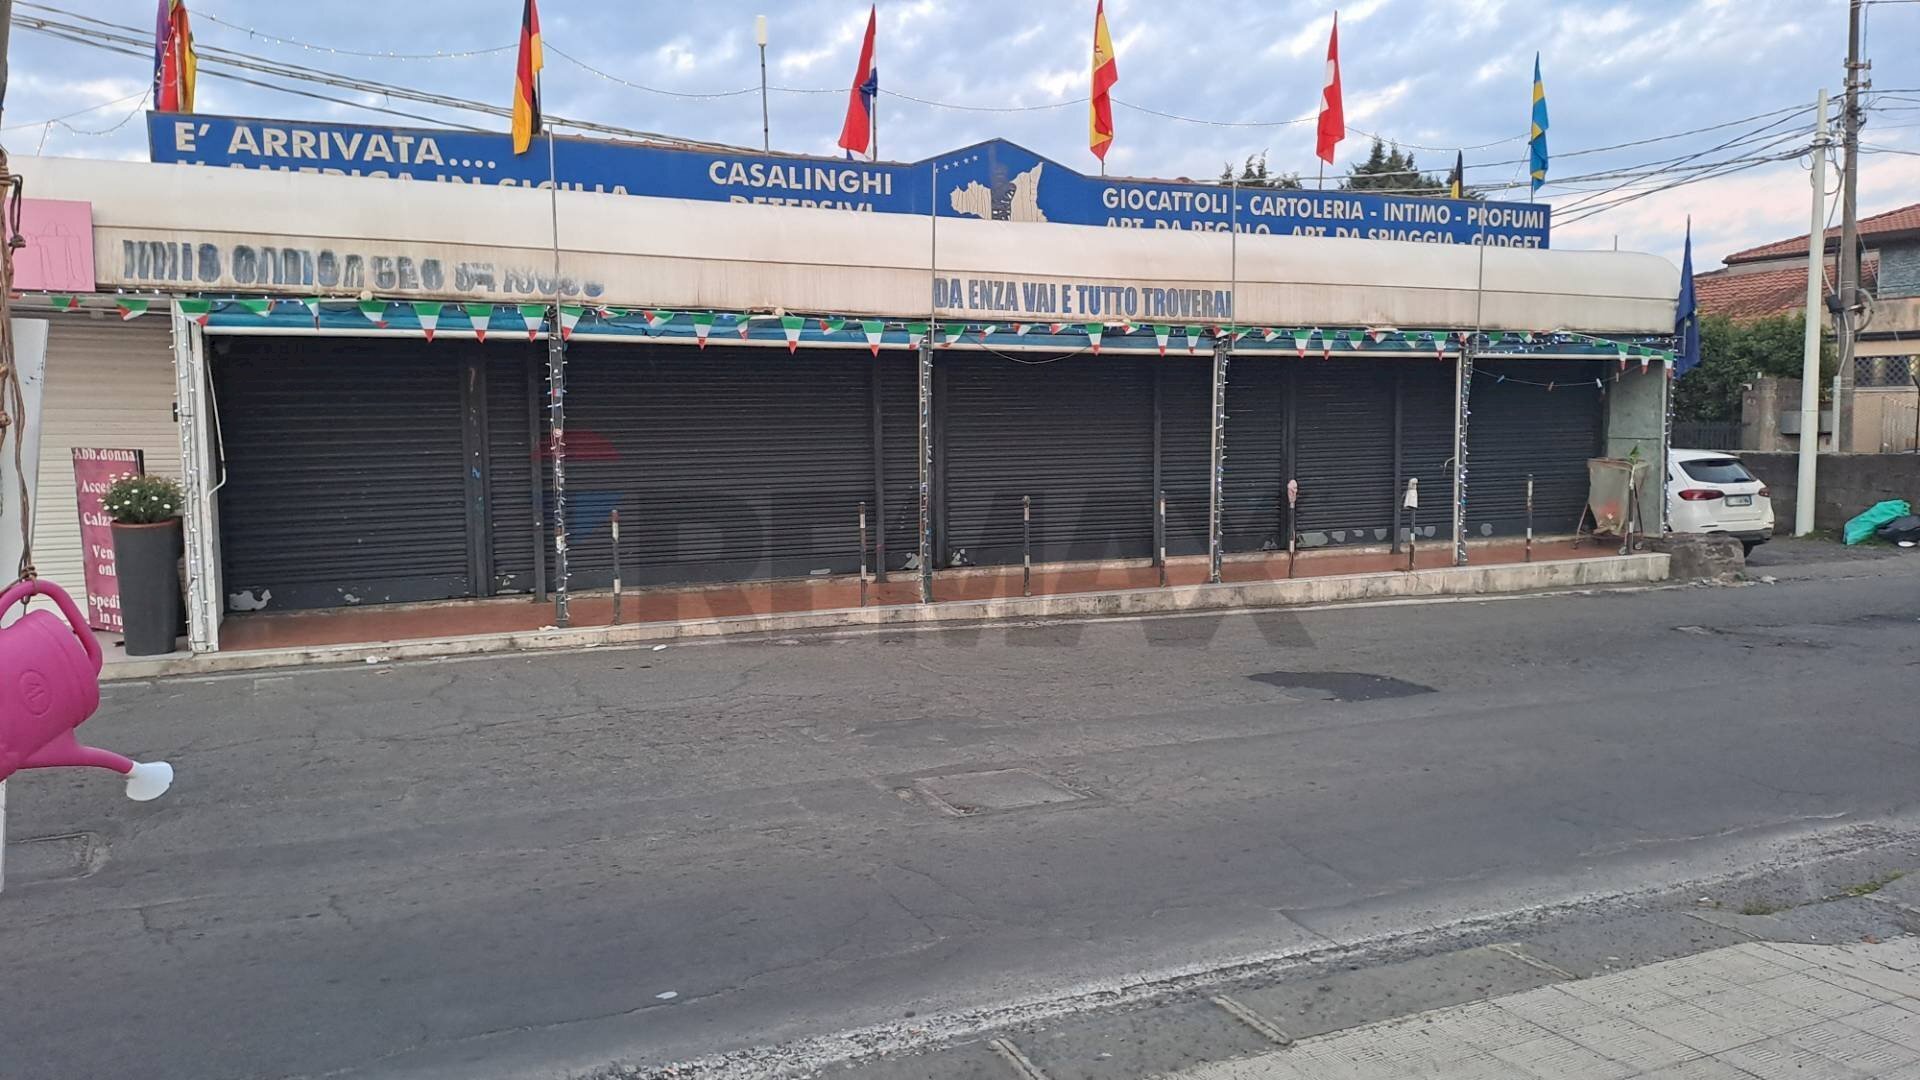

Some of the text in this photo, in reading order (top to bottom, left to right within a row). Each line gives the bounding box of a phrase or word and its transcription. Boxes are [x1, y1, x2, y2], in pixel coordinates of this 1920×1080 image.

[708, 160, 892, 195] CASALINGHI
[1102, 187, 1227, 214] GIOCATTOLI
[1250, 195, 1364, 220] CARTOLERIA
[1383, 202, 1451, 225] INTIMO
[1467, 207, 1544, 229] PROFUMI
[1471, 233, 1542, 249] GADGET
[934, 277, 1232, 319] DA ENZA VAI E TUTTO TROVERAI
